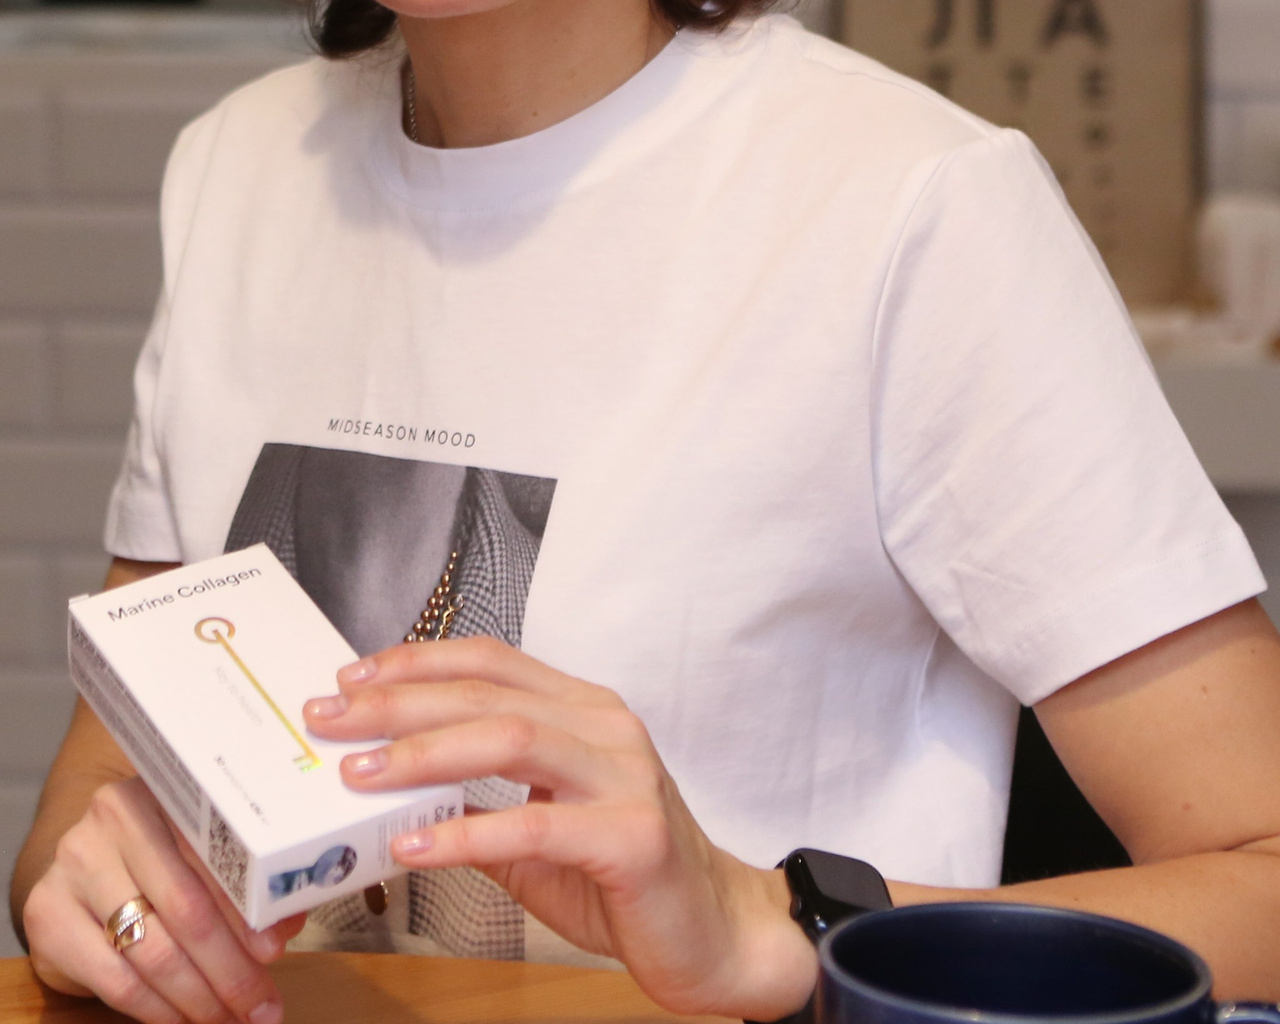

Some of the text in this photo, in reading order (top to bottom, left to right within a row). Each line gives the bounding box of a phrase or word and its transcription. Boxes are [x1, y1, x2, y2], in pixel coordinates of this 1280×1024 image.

[327, 418, 476, 449] MIDSEASON MOOD
[107, 567, 262, 623] Marine Collagen
